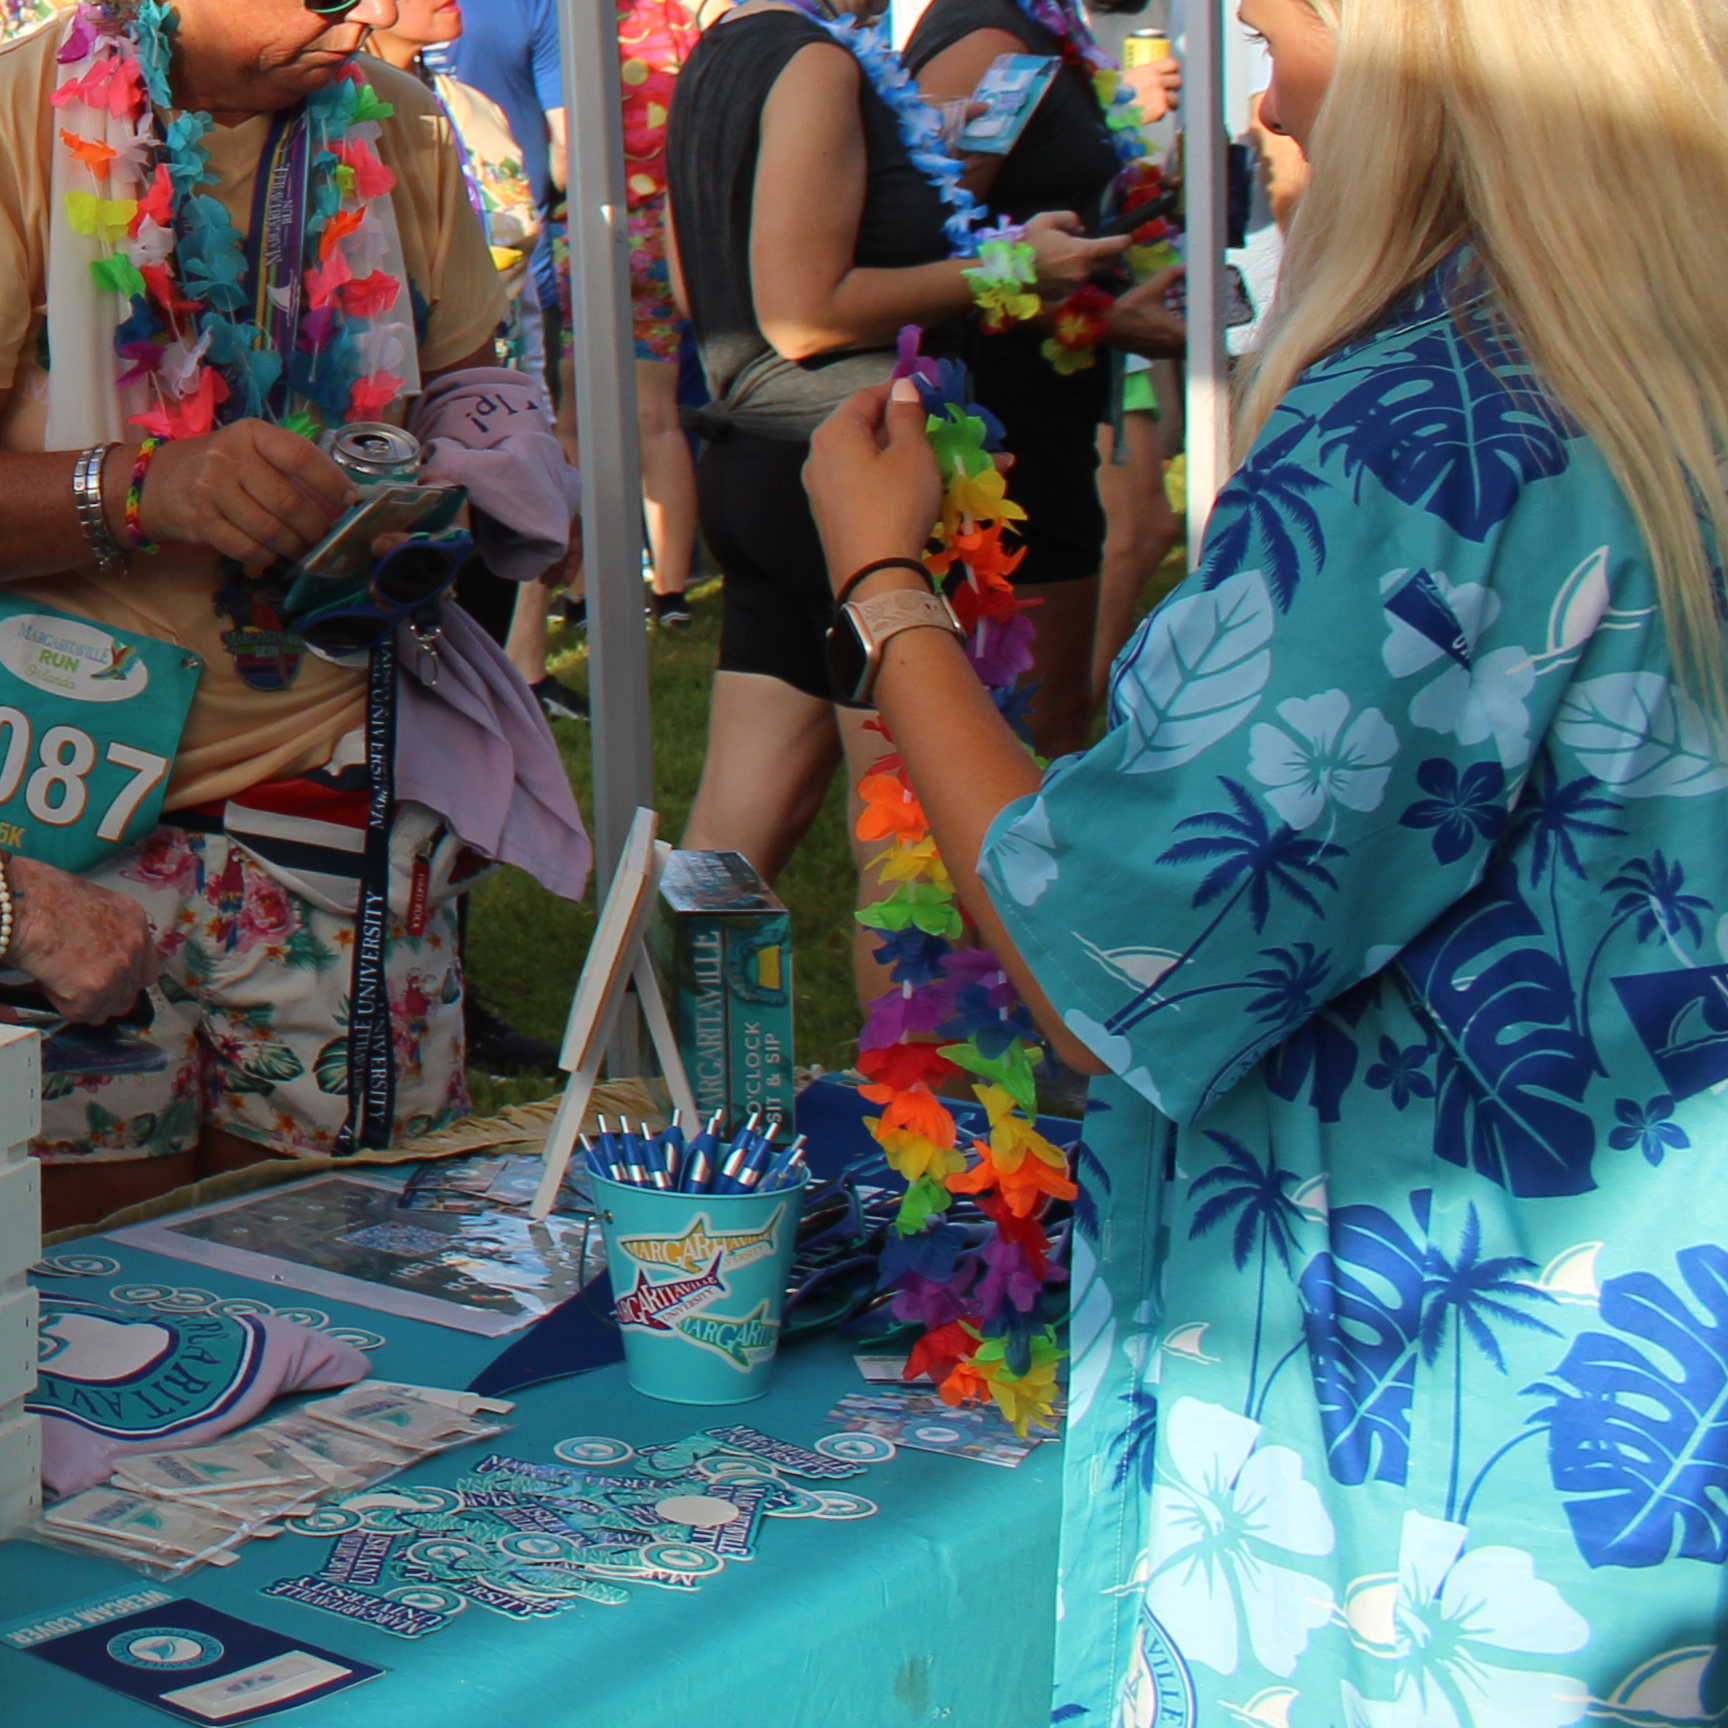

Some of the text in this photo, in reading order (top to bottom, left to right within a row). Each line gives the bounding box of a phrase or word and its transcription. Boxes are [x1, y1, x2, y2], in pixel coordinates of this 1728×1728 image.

[25, 663, 77, 690] Orlando
[38, 648, 80, 673] RUN
[357, 890, 385, 1015] UNIVERSITY
[745, 1022, 762, 1116] O'CLOCK
[765, 1033, 783, 1123] SIT & SIP
[660, 1288, 715, 1322] UNIVERSITY
[6, 1589, 173, 1645] WEBCAM COVER
[265, 1581, 427, 1635] MARGARITAVILLE
[298, 1576, 444, 1626] UNIVERSITY
